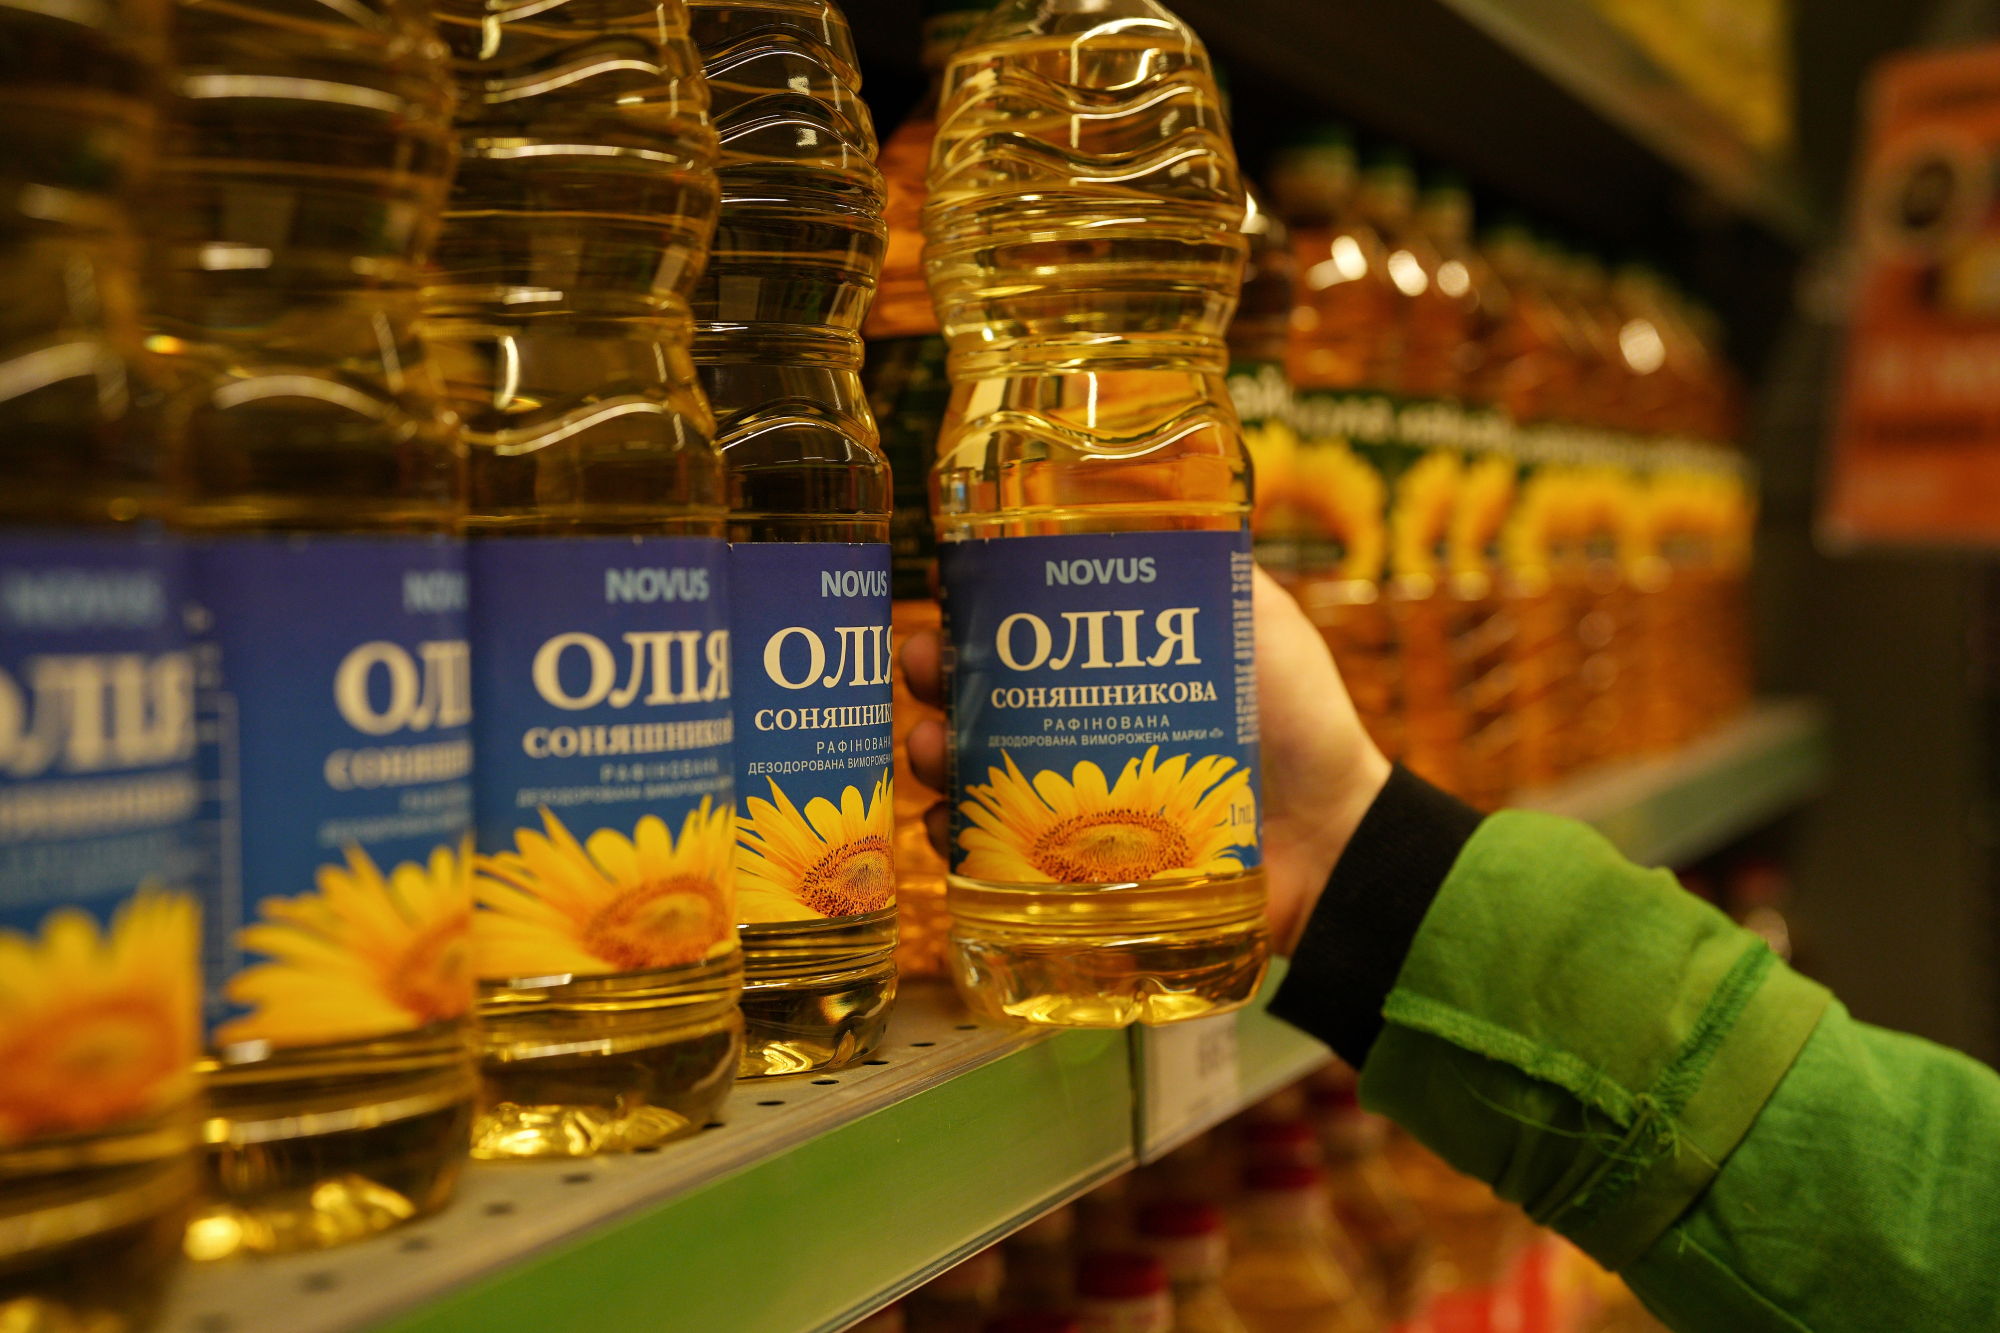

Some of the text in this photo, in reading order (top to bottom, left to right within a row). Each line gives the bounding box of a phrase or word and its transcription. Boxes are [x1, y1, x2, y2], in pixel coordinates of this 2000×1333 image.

[605, 567, 709, 603] NOVUS
[821, 570, 888, 598] NOVUS
[1045, 556, 1157, 586] NOVUS
[995, 607, 1202, 672] ОЛІЯ
[531, 629, 731, 711] ОЛІЯ
[991, 680, 1218, 709] СОНЯШНИКОВА
[1043, 714, 1170, 732] РАФІНОВАНА
[816, 735, 892, 755] РАФІНОВАНА
[988, 734, 1078, 748] ДЕЗОДОРОВАНА
[1081, 732, 1169, 746] ВИМОРОЖЕНА
[1172, 729, 1208, 742] МАРКИ
[748, 758, 845, 776] ДЕЗОДОРОВАНА
